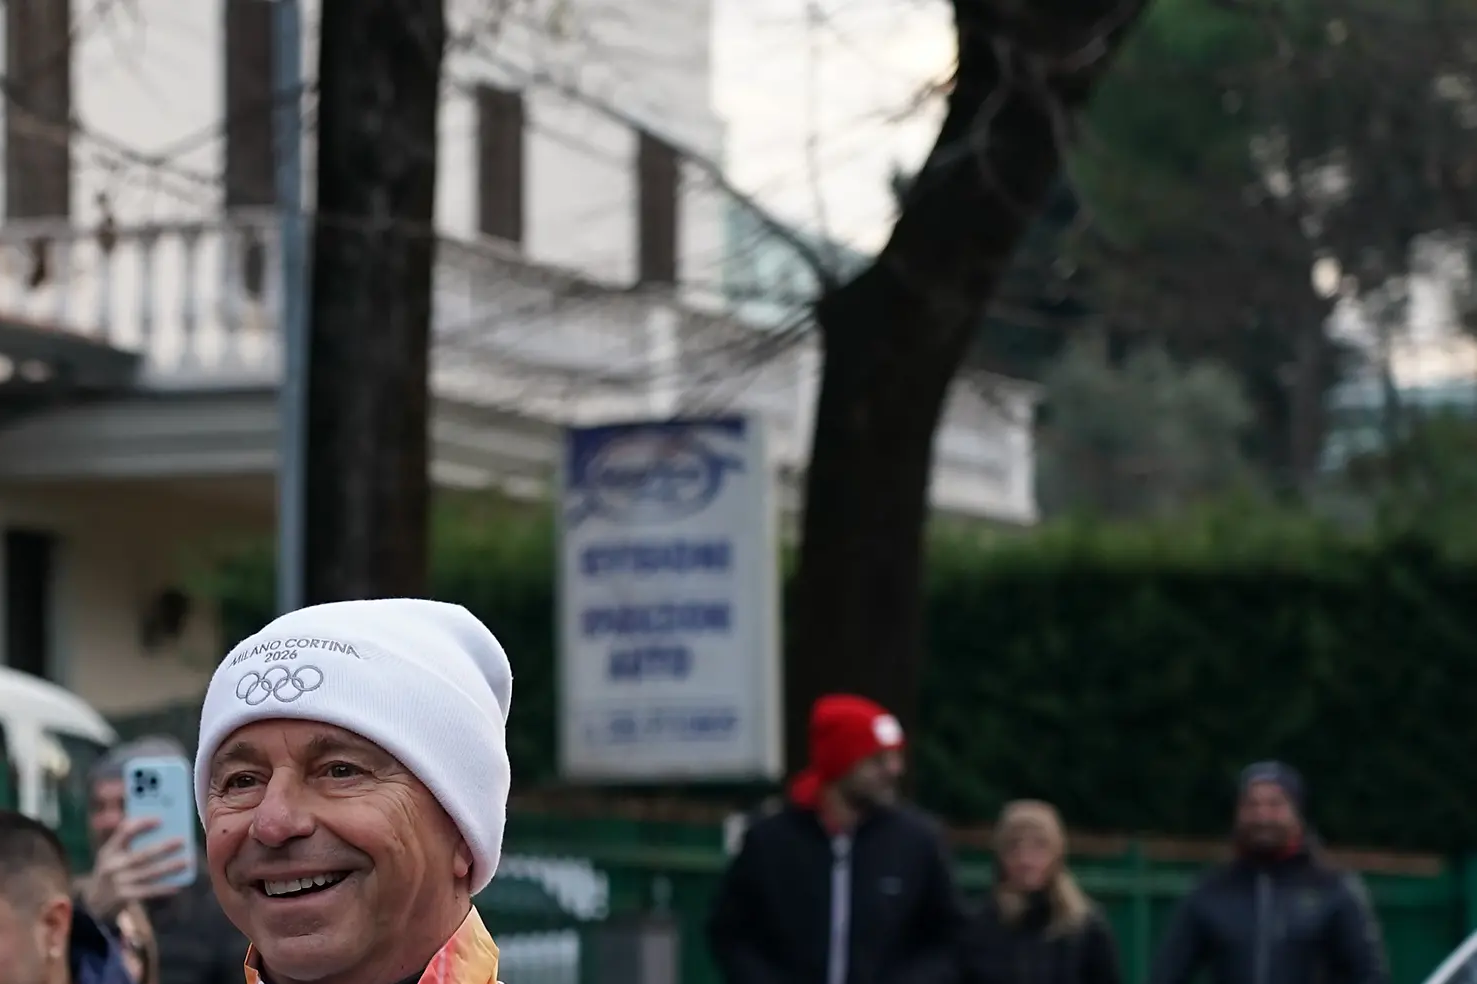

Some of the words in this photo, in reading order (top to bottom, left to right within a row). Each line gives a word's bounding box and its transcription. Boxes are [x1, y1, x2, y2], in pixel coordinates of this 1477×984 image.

[227, 639, 281, 669] MILANO
[284, 637, 361, 660] CORTINA
[264, 650, 298, 663] 2026
